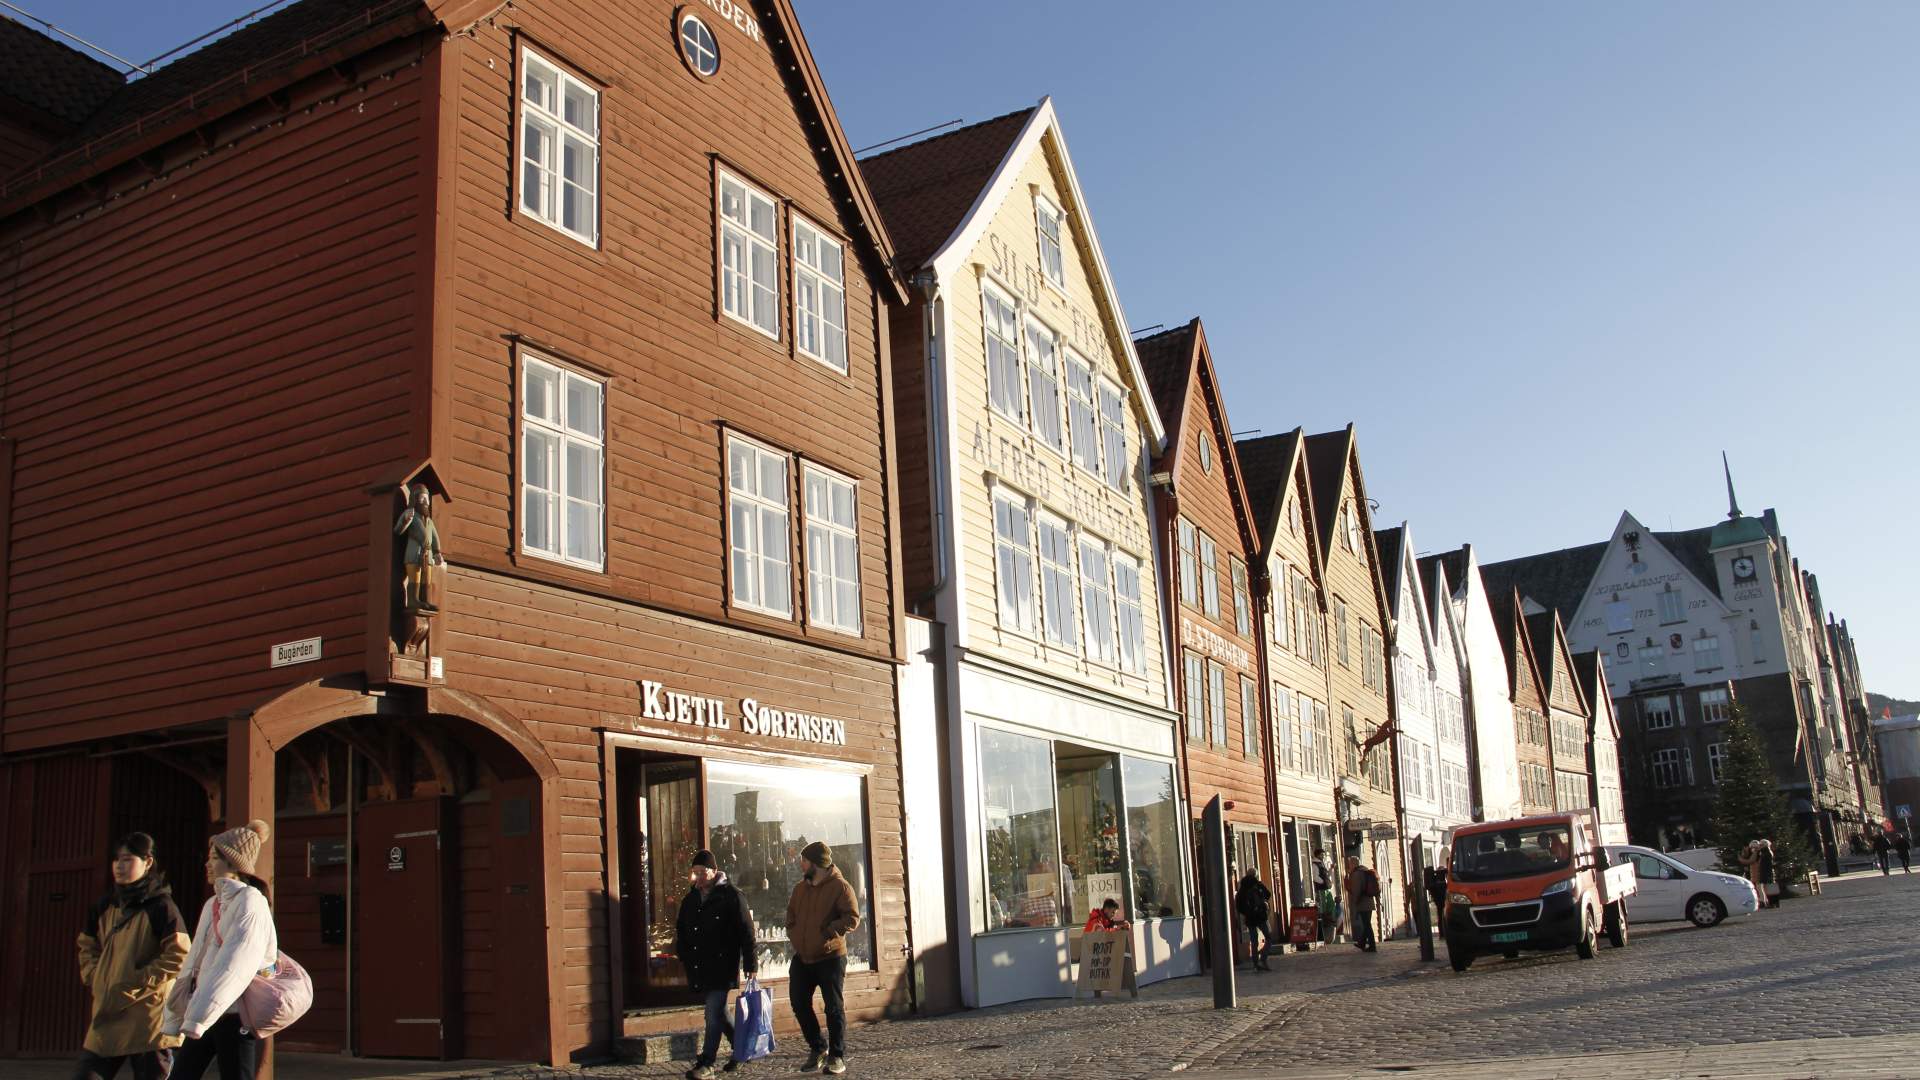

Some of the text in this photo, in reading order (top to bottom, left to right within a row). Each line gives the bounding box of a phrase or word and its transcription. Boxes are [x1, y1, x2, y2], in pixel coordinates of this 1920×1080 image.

[990, 232, 1039, 307] SILD
[973, 420, 1144, 554] ALFRED SKULSTAD
[278, 643, 313, 661] Bugården
[641, 679, 846, 746] KJETIL SØRENSEN
[1090, 878, 1118, 893] ROST
